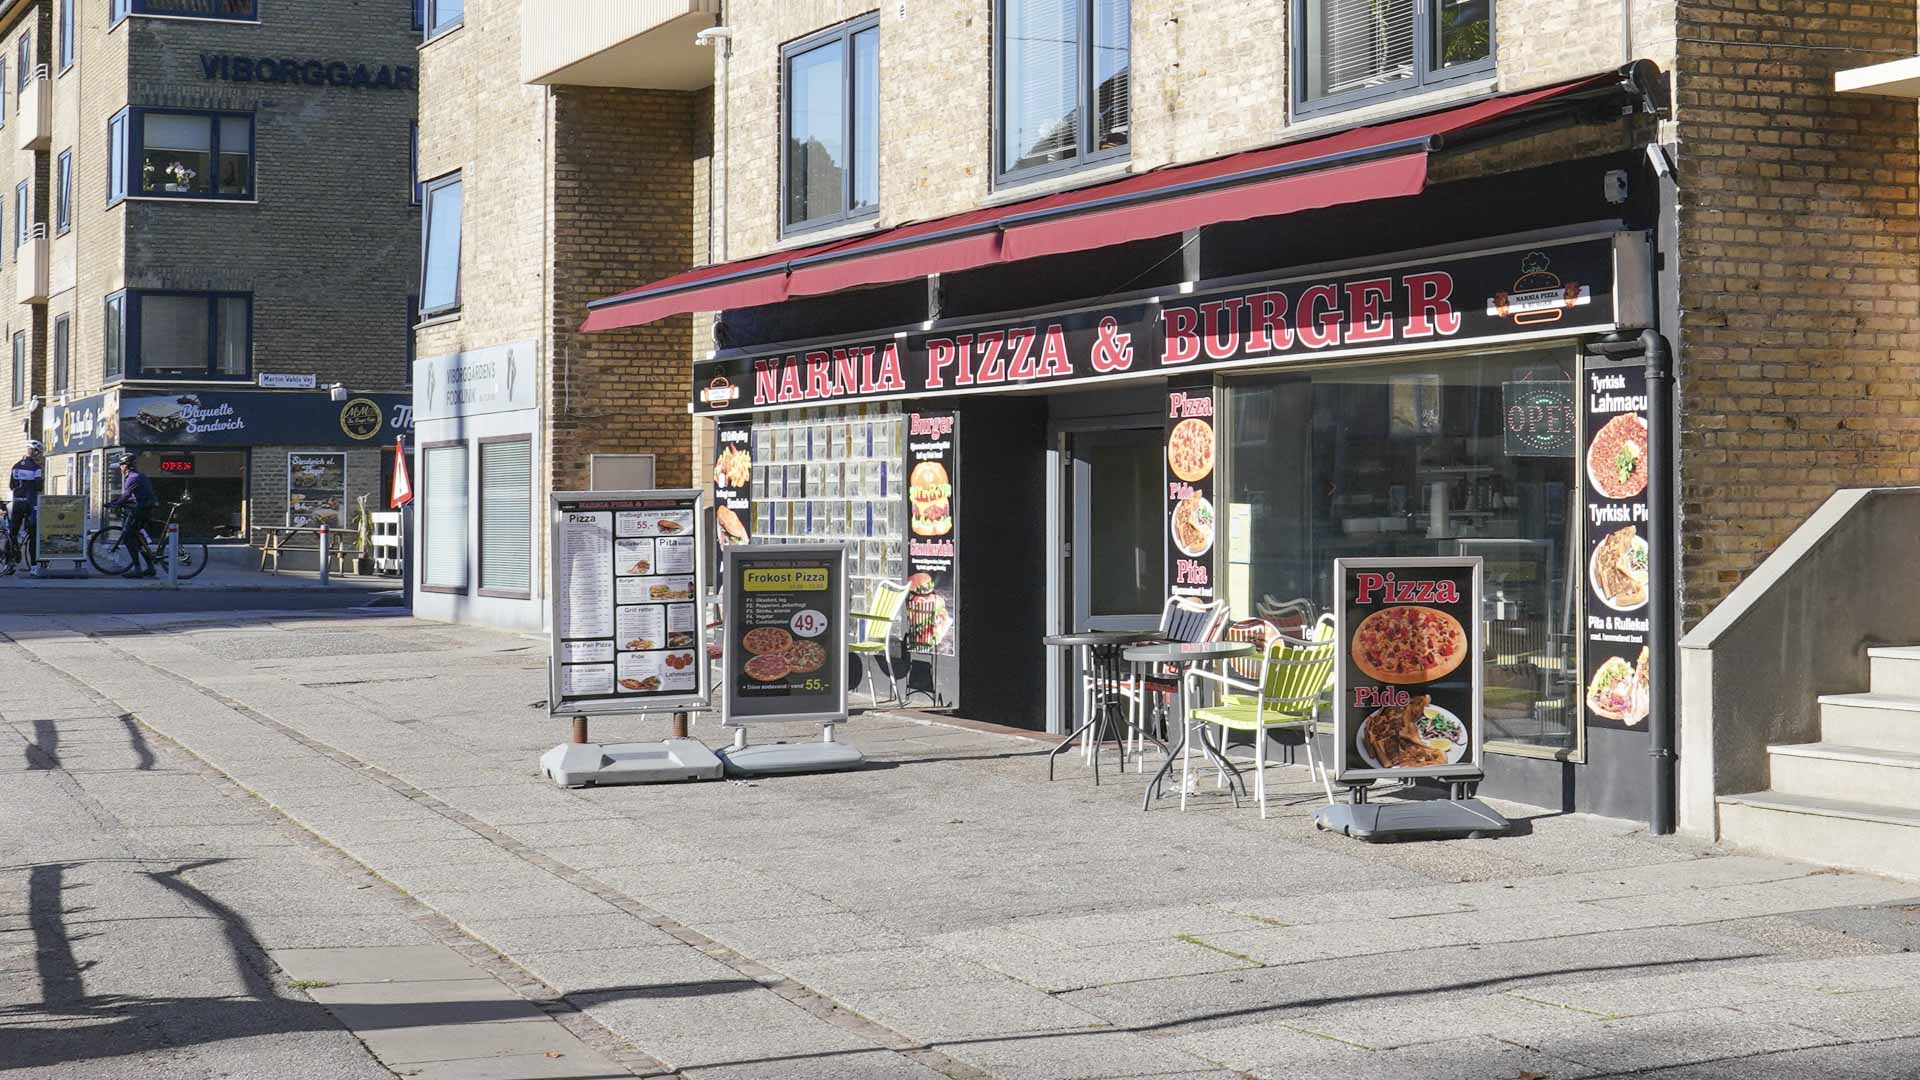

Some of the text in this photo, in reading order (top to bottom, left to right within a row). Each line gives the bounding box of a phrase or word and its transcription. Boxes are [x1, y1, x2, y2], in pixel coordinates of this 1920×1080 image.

[1516, 291, 1559, 302] NARNIA PIZZA
[754, 271, 1461, 405] NARNIA PIZZA & BURGER
[264, 375, 284, 383] Martin
[303, 375, 313, 385] Vej
[1591, 373, 1625, 393] Tyrkisk
[180, 403, 234, 421] Baguette
[1170, 392, 1213, 418] Pizza
[186, 416, 245, 434] Sandwich
[910, 413, 954, 440] Burger
[161, 461, 191, 471] OPEN
[291, 456, 325, 465] Sandwich
[1169, 482, 1195, 500] Pide
[569, 514, 596, 524] Pizza
[1589, 504, 1631, 526] Tyrkisk
[659, 538, 678, 547] Pita
[748, 572, 825, 582] Frokost Pizza
[1176, 559, 1208, 585] Pita
[1355, 572, 1460, 604] Pizza
[794, 614, 825, 634] 49,-
[805, 679, 829, 692] 55,-
[1354, 686, 1410, 707] Pide
